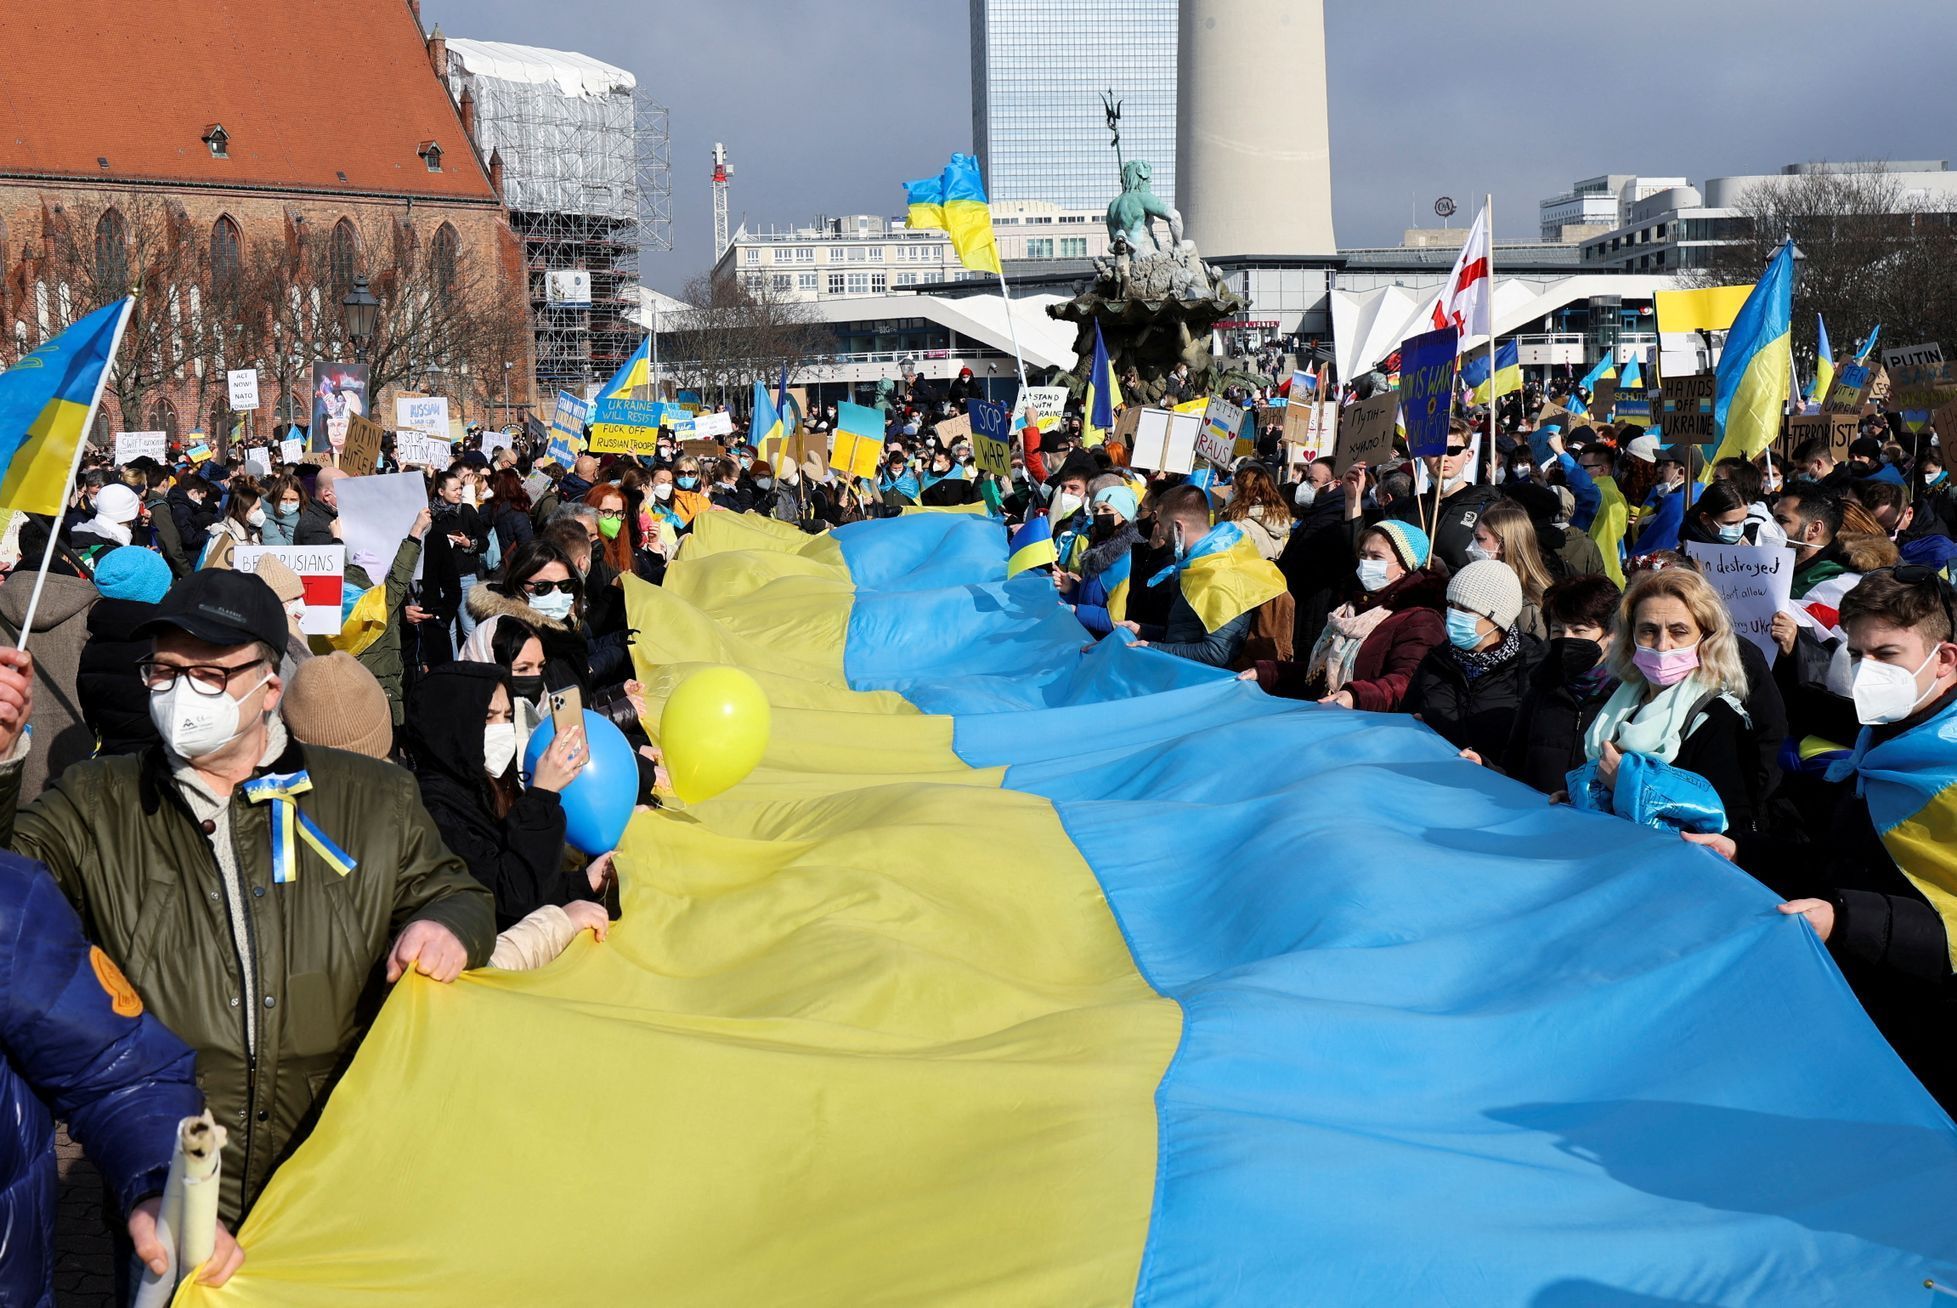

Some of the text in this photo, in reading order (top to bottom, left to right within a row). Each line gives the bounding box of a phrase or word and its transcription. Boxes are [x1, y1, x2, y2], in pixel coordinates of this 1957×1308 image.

[1889, 350, 1942, 367] PUTIN
[1428, 360, 1453, 396] WAR
[1836, 363, 1877, 385] STAND
[1033, 393, 1060, 401] STAND
[1665, 379, 1713, 398] HANDS
[608, 400, 654, 412] UKRAINE
[1210, 396, 1240, 421] PUTIN
[1676, 400, 1695, 411] OFF
[602, 410, 624, 420] WILL
[627, 411, 656, 424] RESIST
[979, 404, 1002, 435] STOP
[1663, 415, 1713, 436] UKRAINE
[350, 416, 380, 448] PUTIN
[404, 431, 424, 444] STOP
[603, 424, 647, 436] FUCK OFF
[399, 443, 429, 460] PUTIN
[597, 437, 655, 451] RUSSIAN TROOPS
[1198, 434, 1229, 464] RAUS
[342, 446, 375, 475] HITLER
[980, 440, 1007, 472] WAR
[242, 553, 335, 572] BEUSIANS
[1717, 552, 1780, 578] destroyed
[1741, 586, 1768, 599] allow
